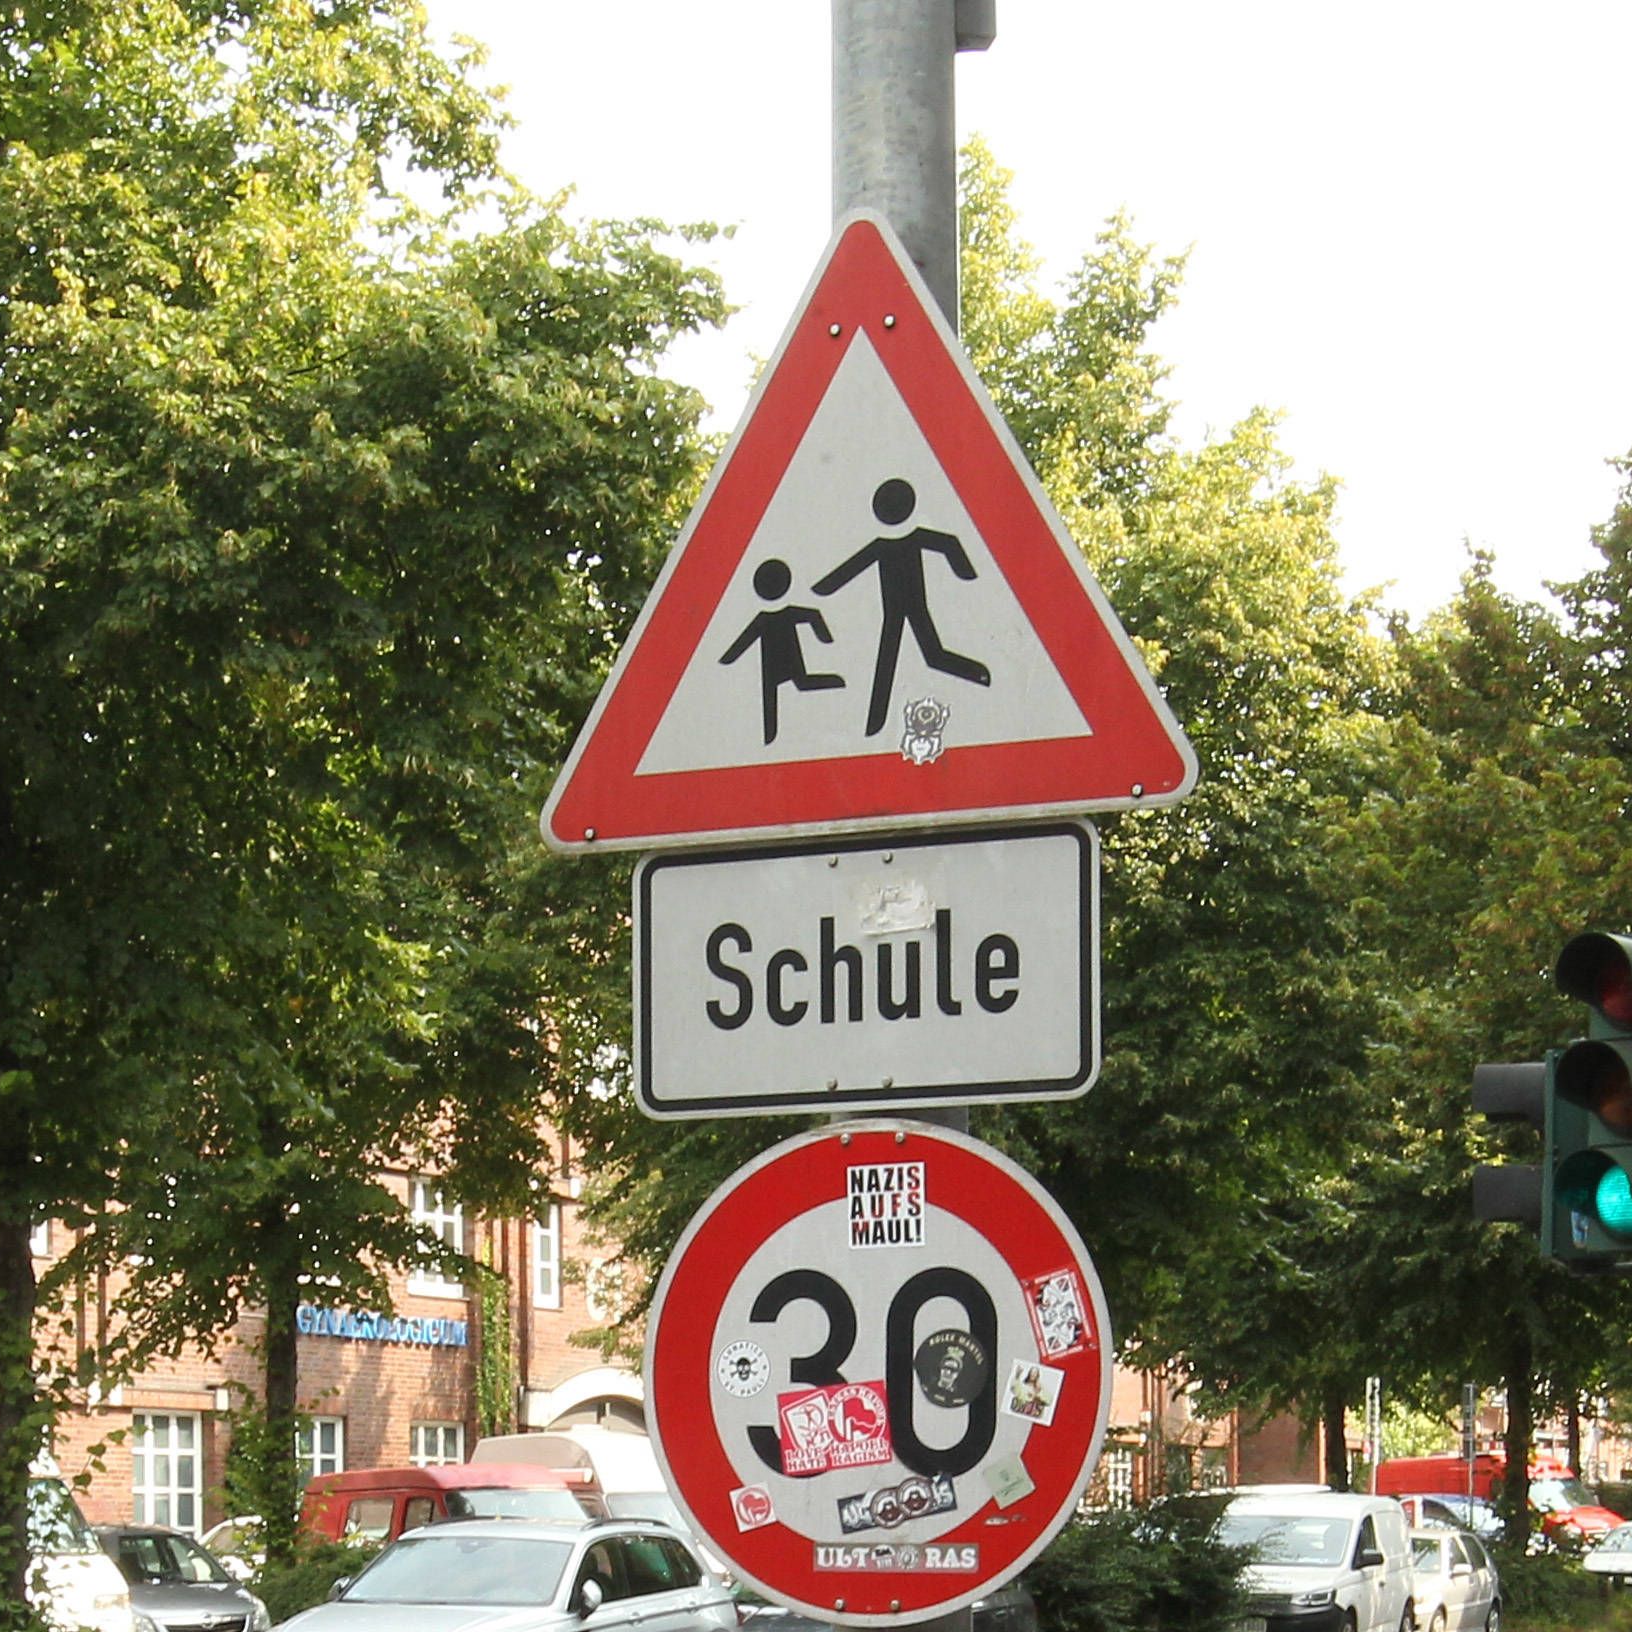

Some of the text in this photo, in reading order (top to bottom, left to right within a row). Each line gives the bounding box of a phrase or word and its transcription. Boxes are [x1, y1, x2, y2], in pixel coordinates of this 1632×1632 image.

[706, 909, 1021, 1030] Schule
[850, 1165, 921, 1193] NAZIS
[850, 1190, 922, 1220] AUFS
[851, 1219, 922, 1246] MAUL!
[748, 1266, 998, 1479] 30
